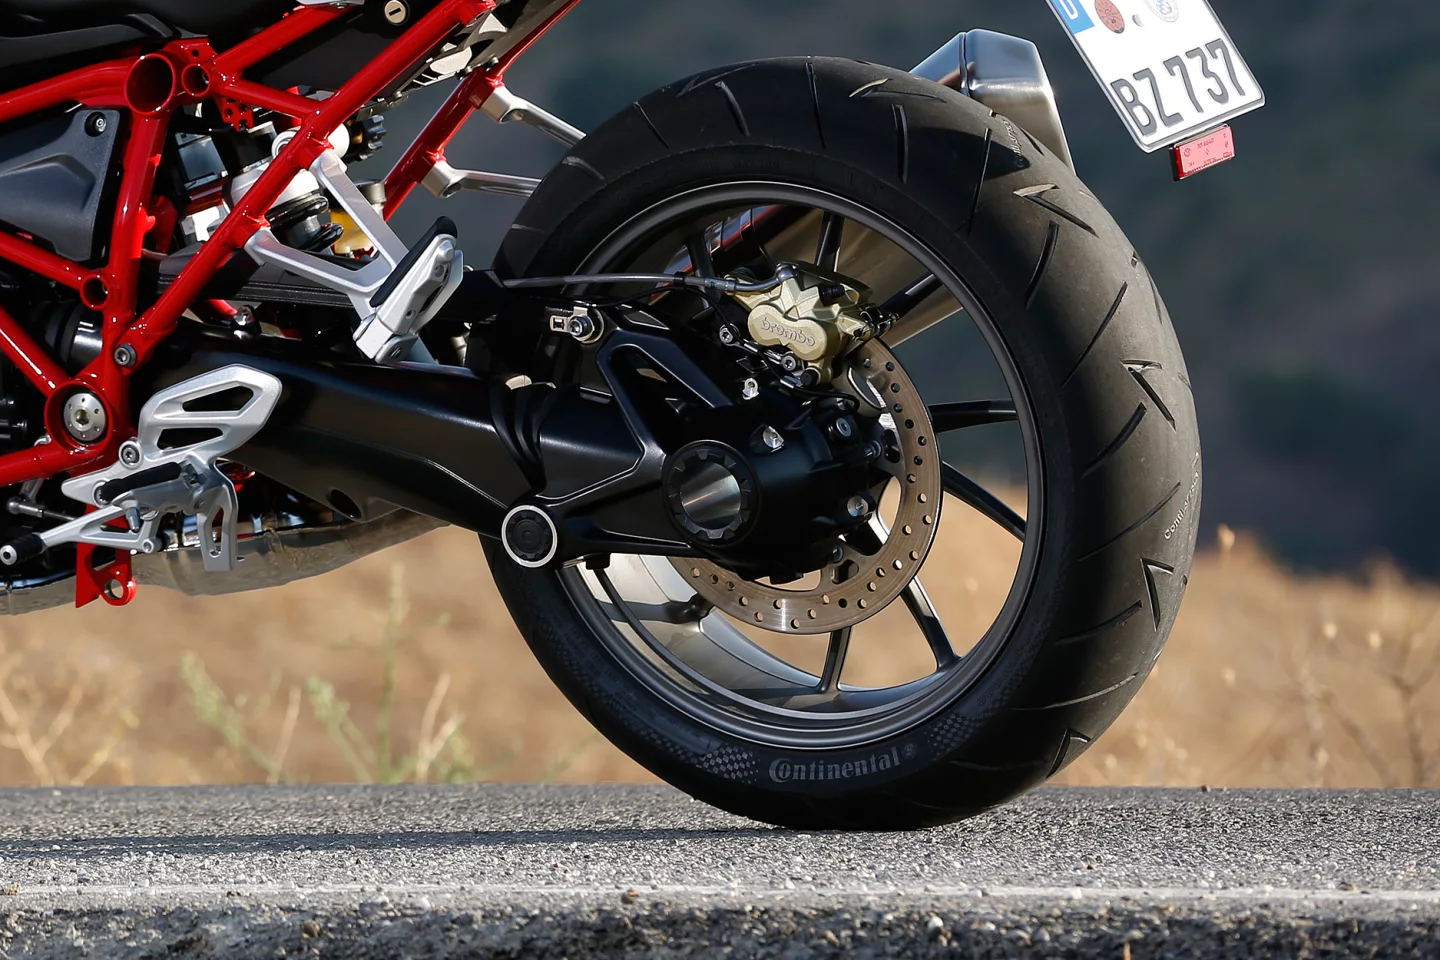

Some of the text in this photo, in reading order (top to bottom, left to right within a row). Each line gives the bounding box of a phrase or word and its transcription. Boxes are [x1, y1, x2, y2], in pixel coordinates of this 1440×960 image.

[1110, 38, 1246, 138] BZ 737
[760, 317, 816, 347] brembo
[768, 745, 901, 784] Continental
